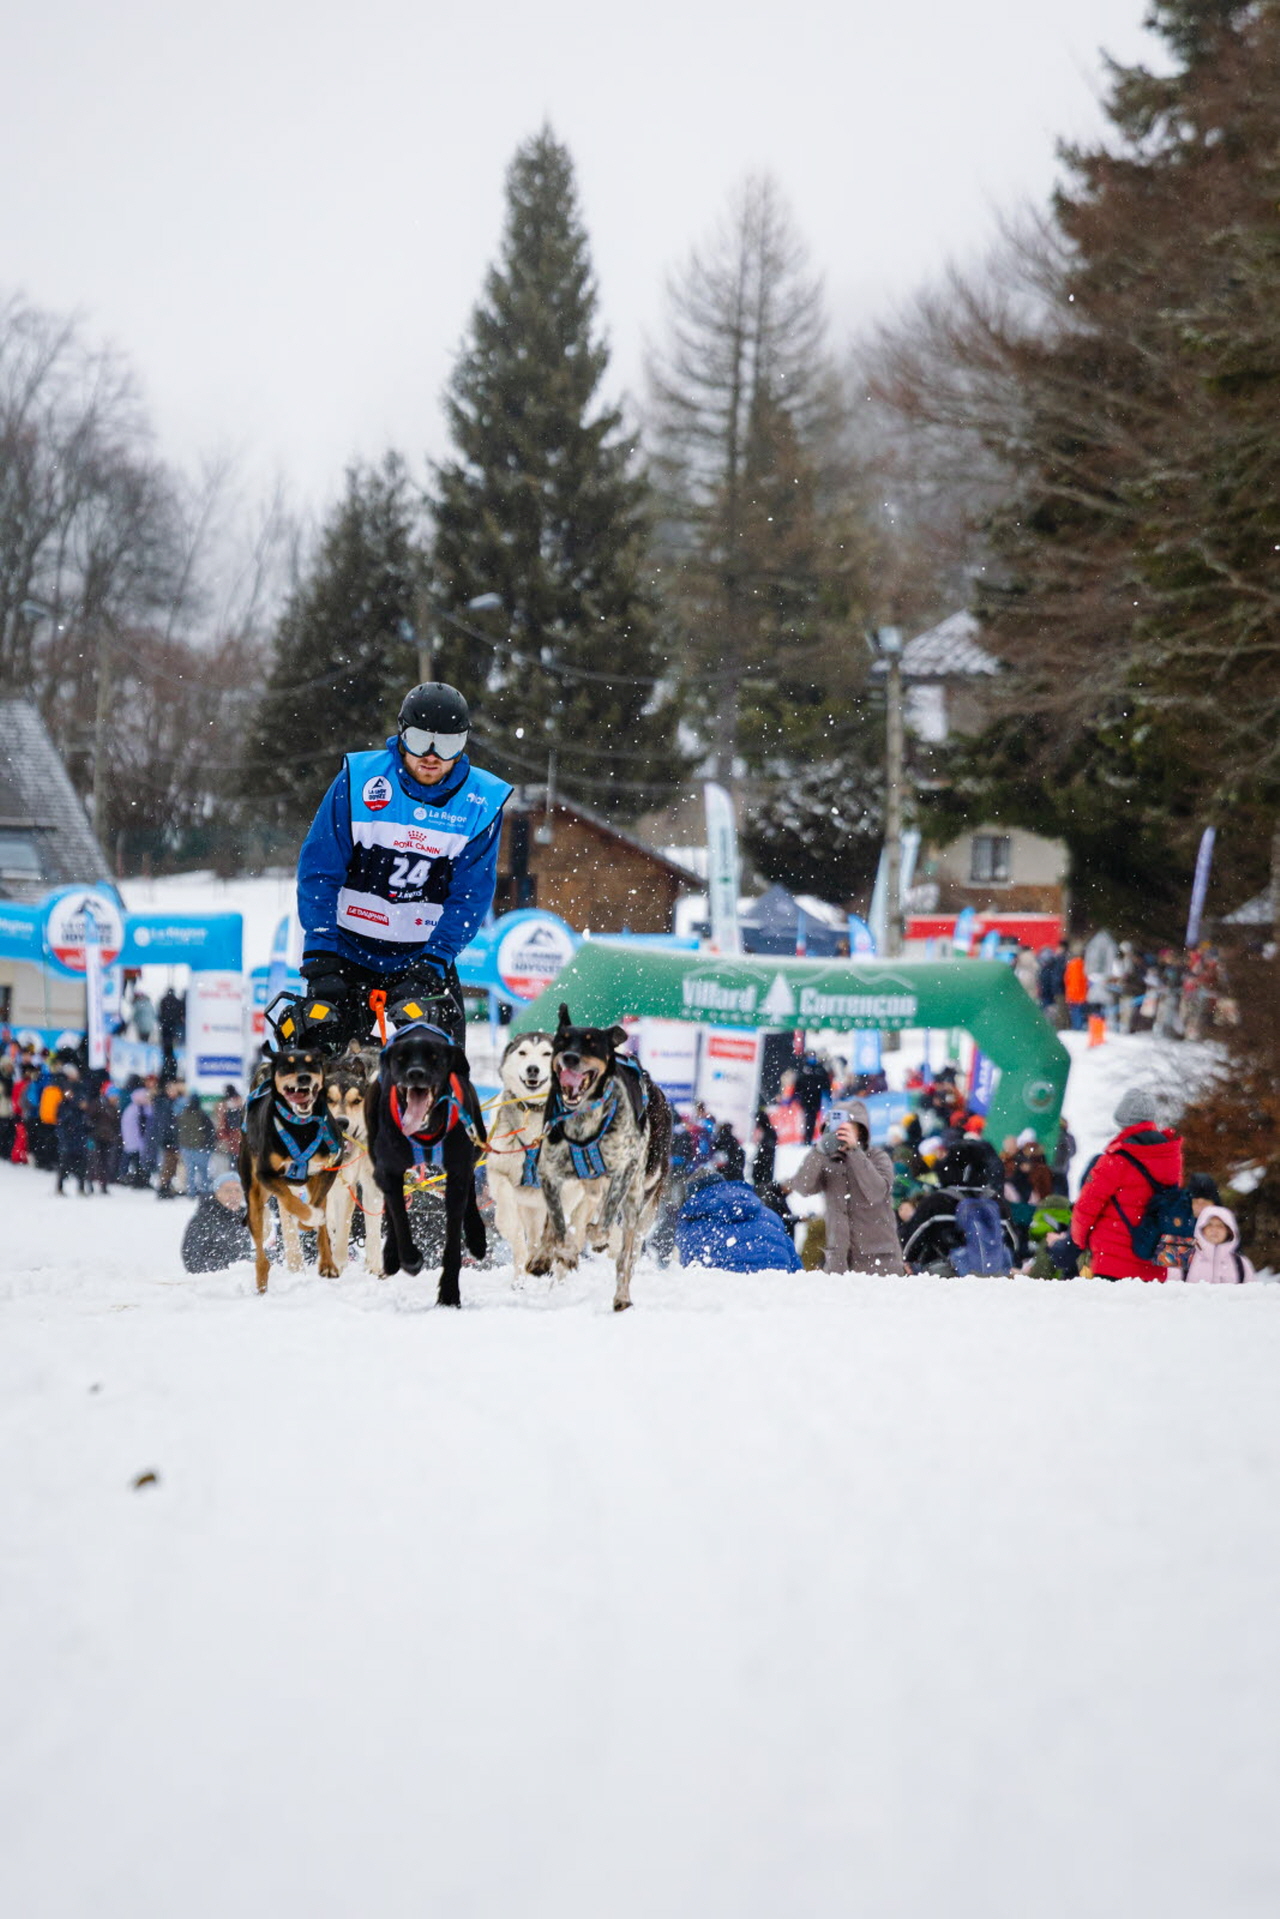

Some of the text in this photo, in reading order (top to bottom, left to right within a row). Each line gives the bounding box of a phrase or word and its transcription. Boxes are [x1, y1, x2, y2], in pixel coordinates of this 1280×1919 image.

[429, 810, 439, 818] La
[415, 843, 441, 855] CANIN
[388, 856, 432, 889] 24
[682, 978, 757, 1013] Villard
